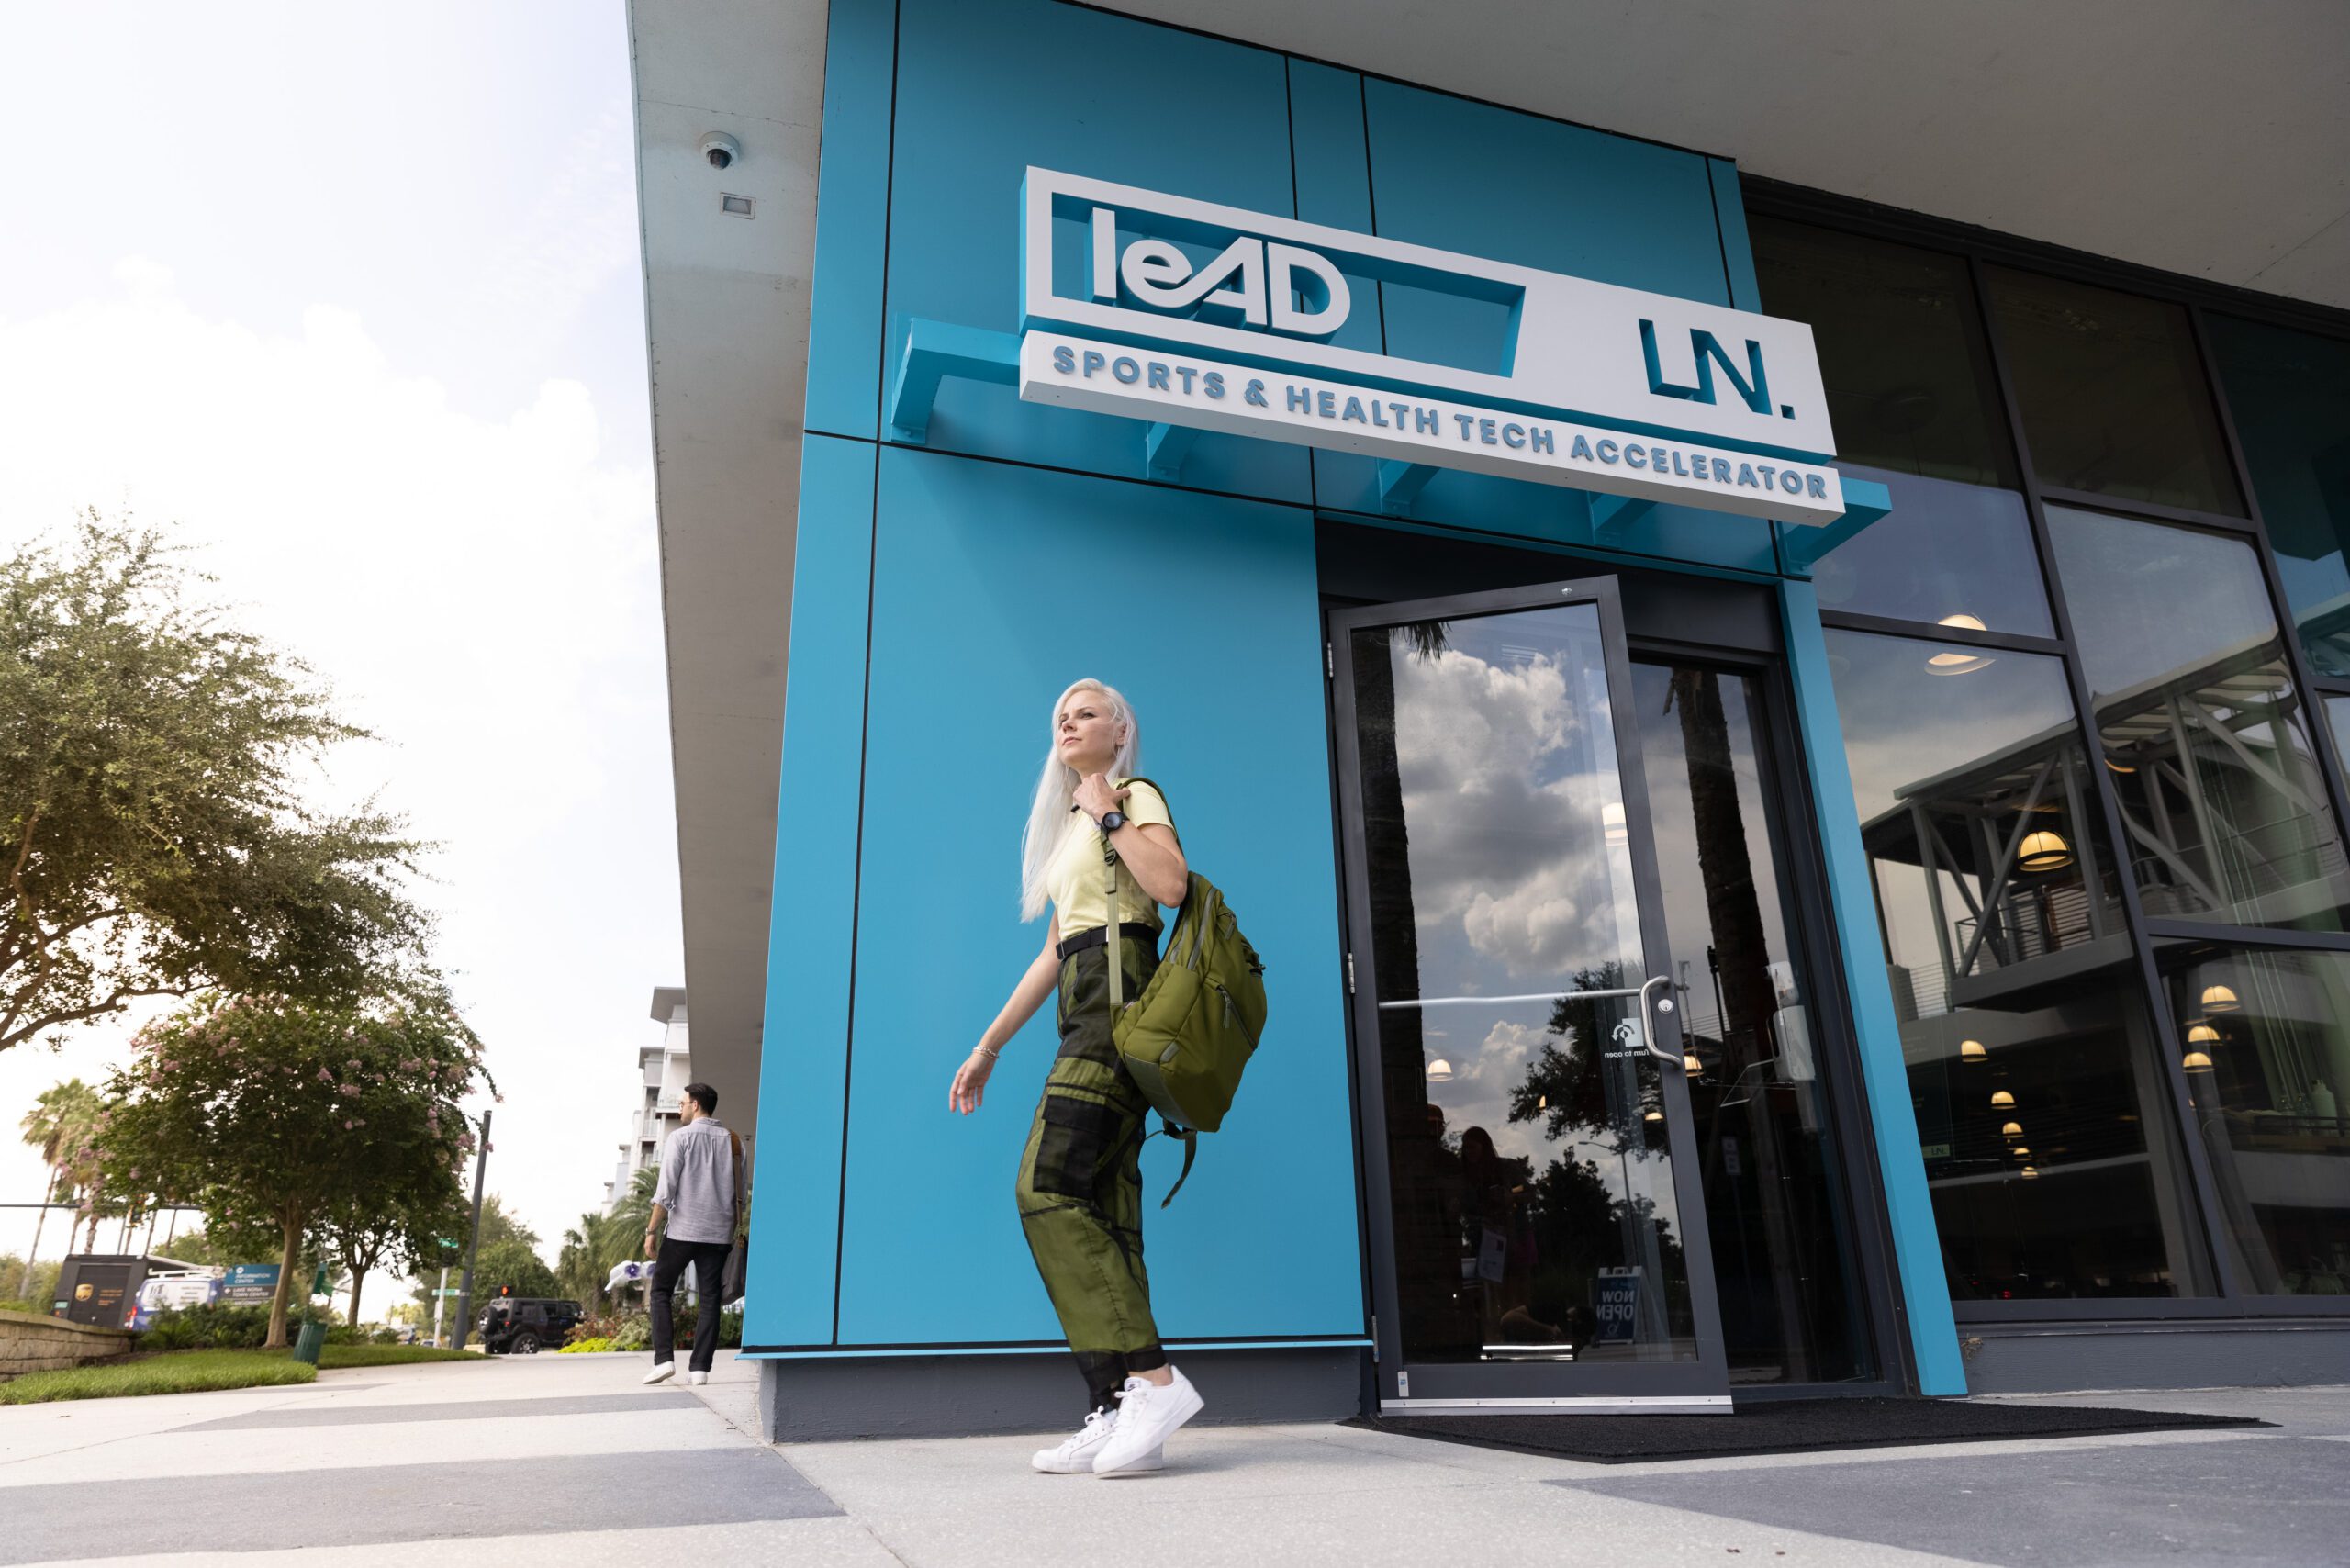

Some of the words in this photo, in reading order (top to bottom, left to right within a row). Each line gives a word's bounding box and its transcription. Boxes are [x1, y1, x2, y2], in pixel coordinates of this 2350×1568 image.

[1092, 207, 1351, 335] leAD
[1053, 345, 1225, 399] SPORTS
[1244, 378, 1269, 408] &
[1286, 385, 1439, 436] HEALTH
[1454, 413, 1555, 454] TECH
[1570, 434, 1827, 499] ACCELERATOR
